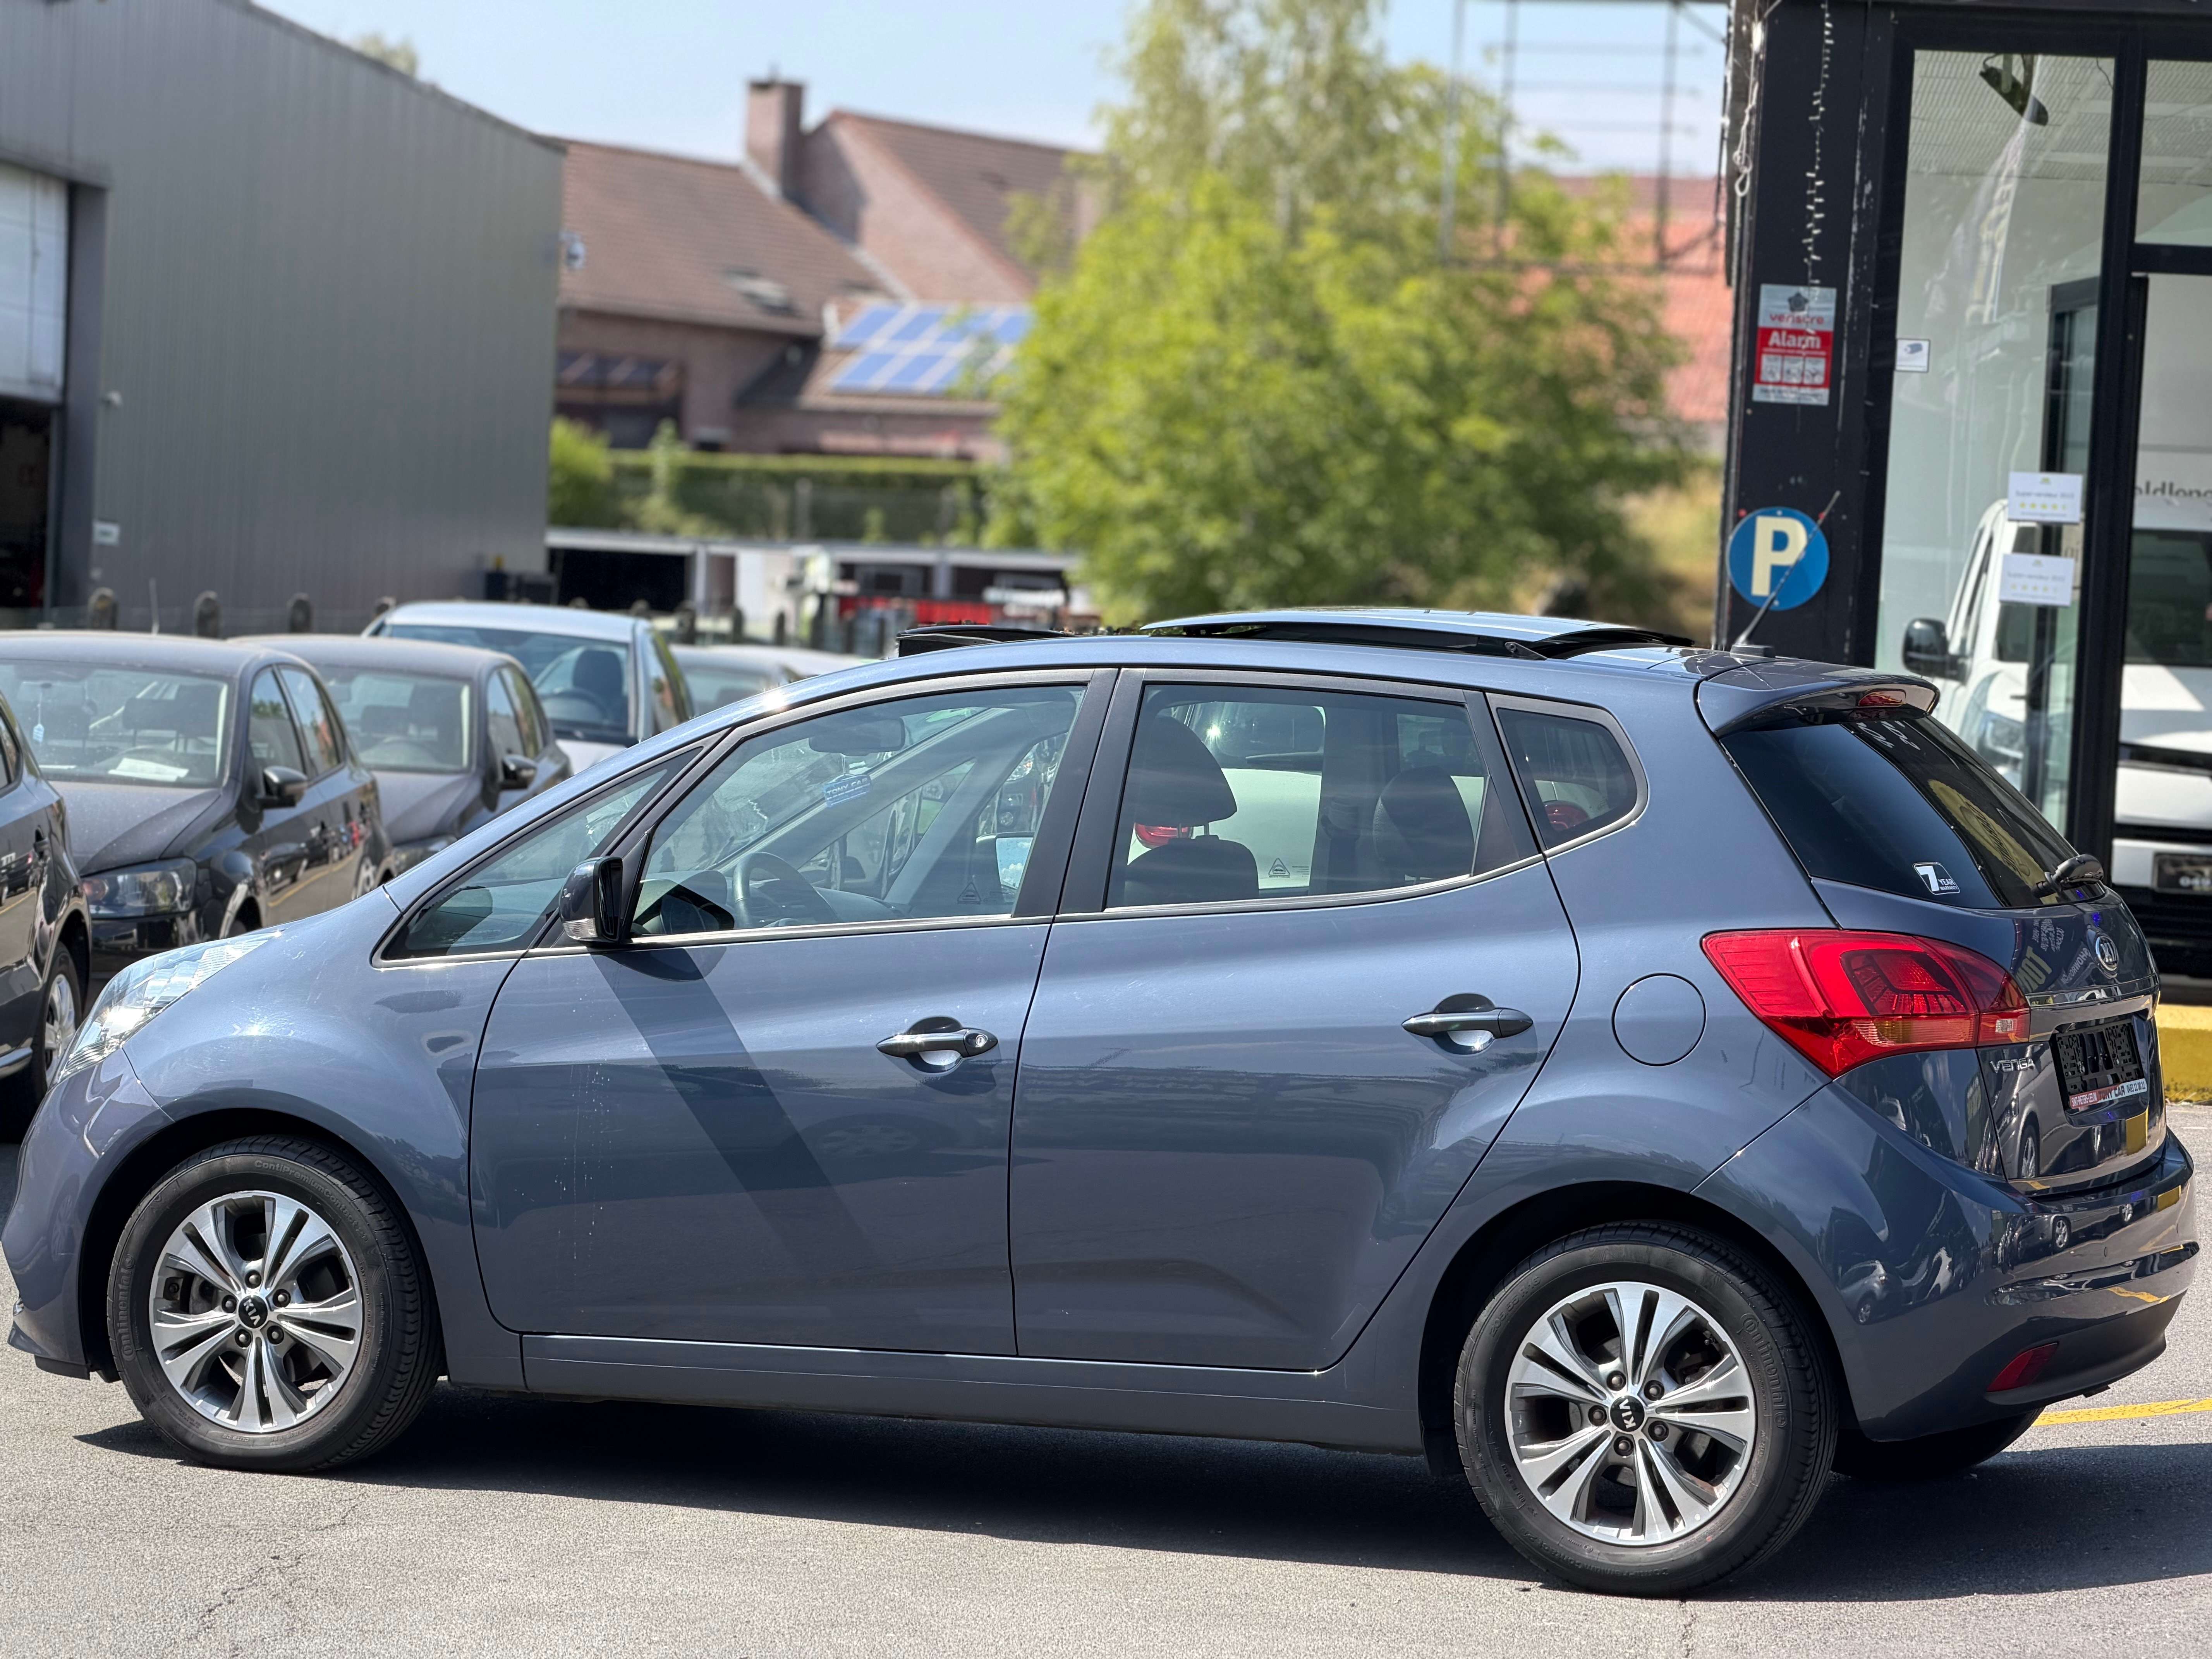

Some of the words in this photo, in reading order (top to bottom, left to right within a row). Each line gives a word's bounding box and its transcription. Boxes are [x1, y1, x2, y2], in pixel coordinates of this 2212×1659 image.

[1768, 331, 1821, 349] Alarm
[1751, 515, 1807, 596] P
[1916, 866, 1939, 891] 7
[1990, 1058, 2035, 1073] VENGA
[2114, 1085, 2125, 1097] CAR
[254, 1160, 359, 1228] ContiPremiumContact
[117, 1268, 136, 1361] Continental
[243, 1298, 261, 1326] KIA
[1736, 1313, 1786, 1410] Continental
[1619, 1399, 1636, 1429] KIA
